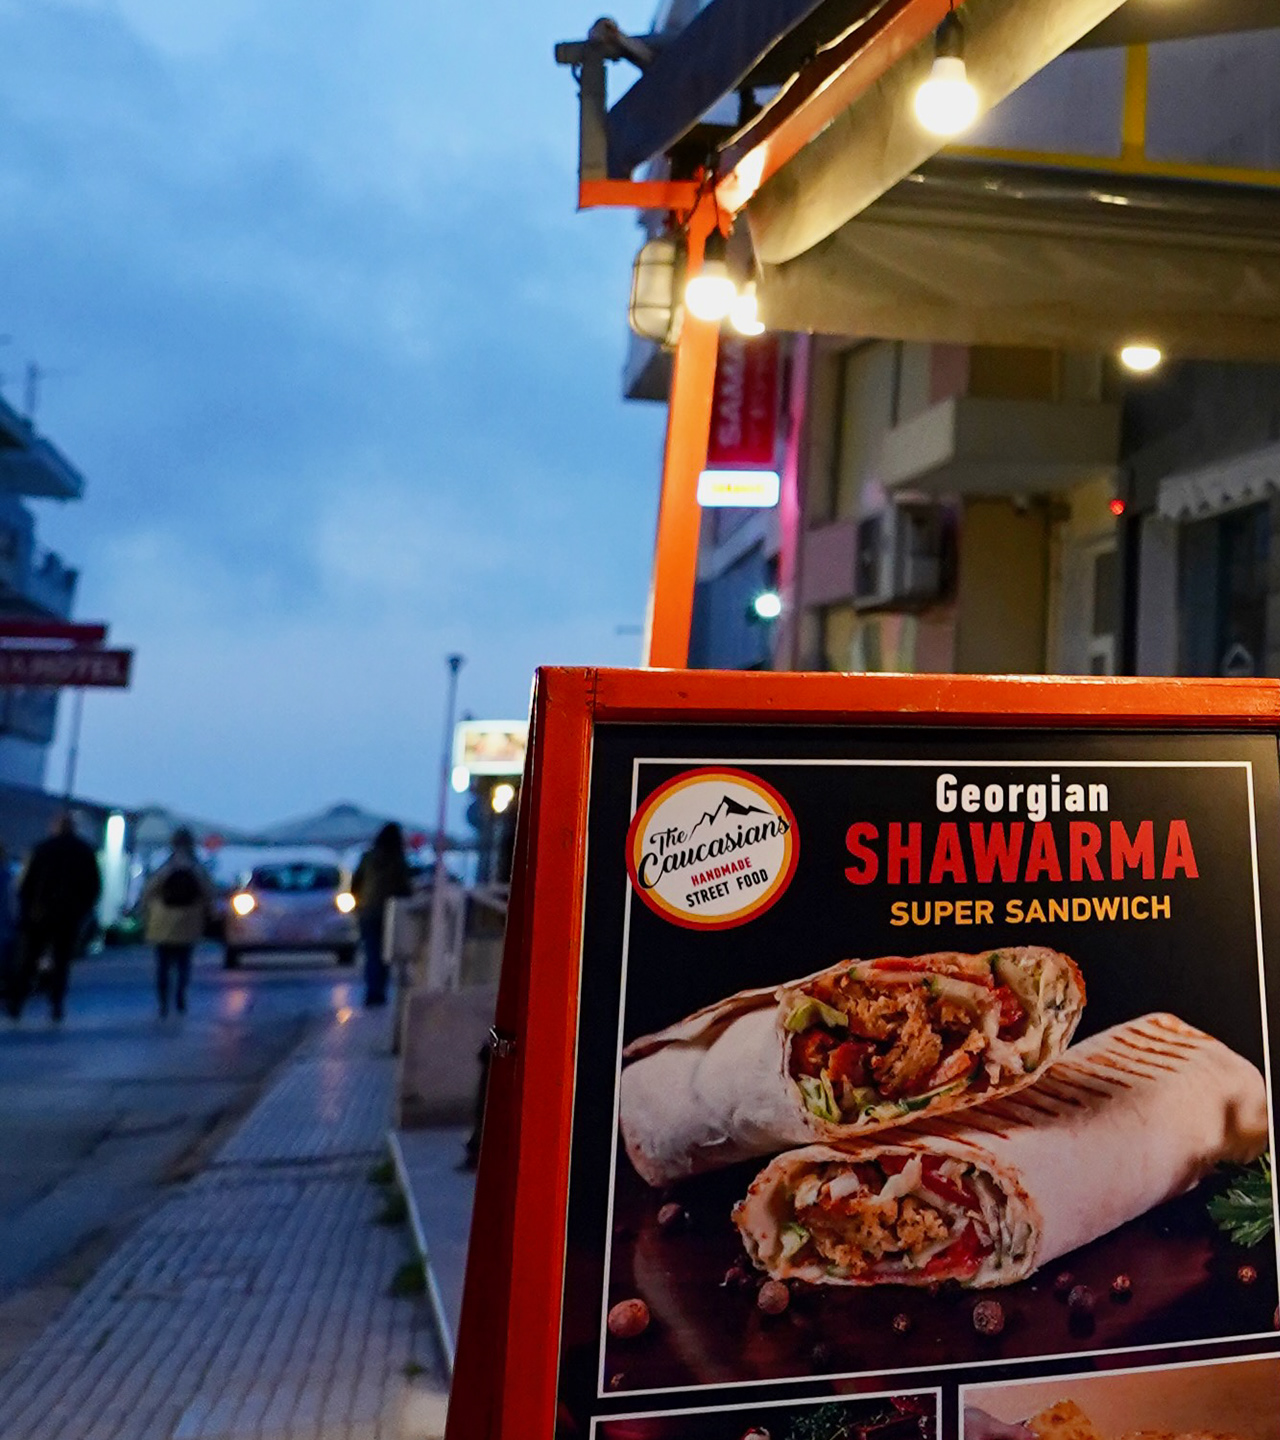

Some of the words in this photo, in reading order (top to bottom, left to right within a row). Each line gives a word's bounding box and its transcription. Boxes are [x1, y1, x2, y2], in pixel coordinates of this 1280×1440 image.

[936, 773, 1109, 822] Georgian
[638, 816, 792, 889] Caucasians
[650, 827, 687, 856] The
[845, 820, 1199, 884] SHAWARMA
[686, 881, 731, 908] STREET
[736, 869, 768, 890] FOOD
[691, 857, 752, 887] HANDMADE
[890, 900, 994, 926] SUPER
[1005, 895, 1171, 924] SANDWICH
